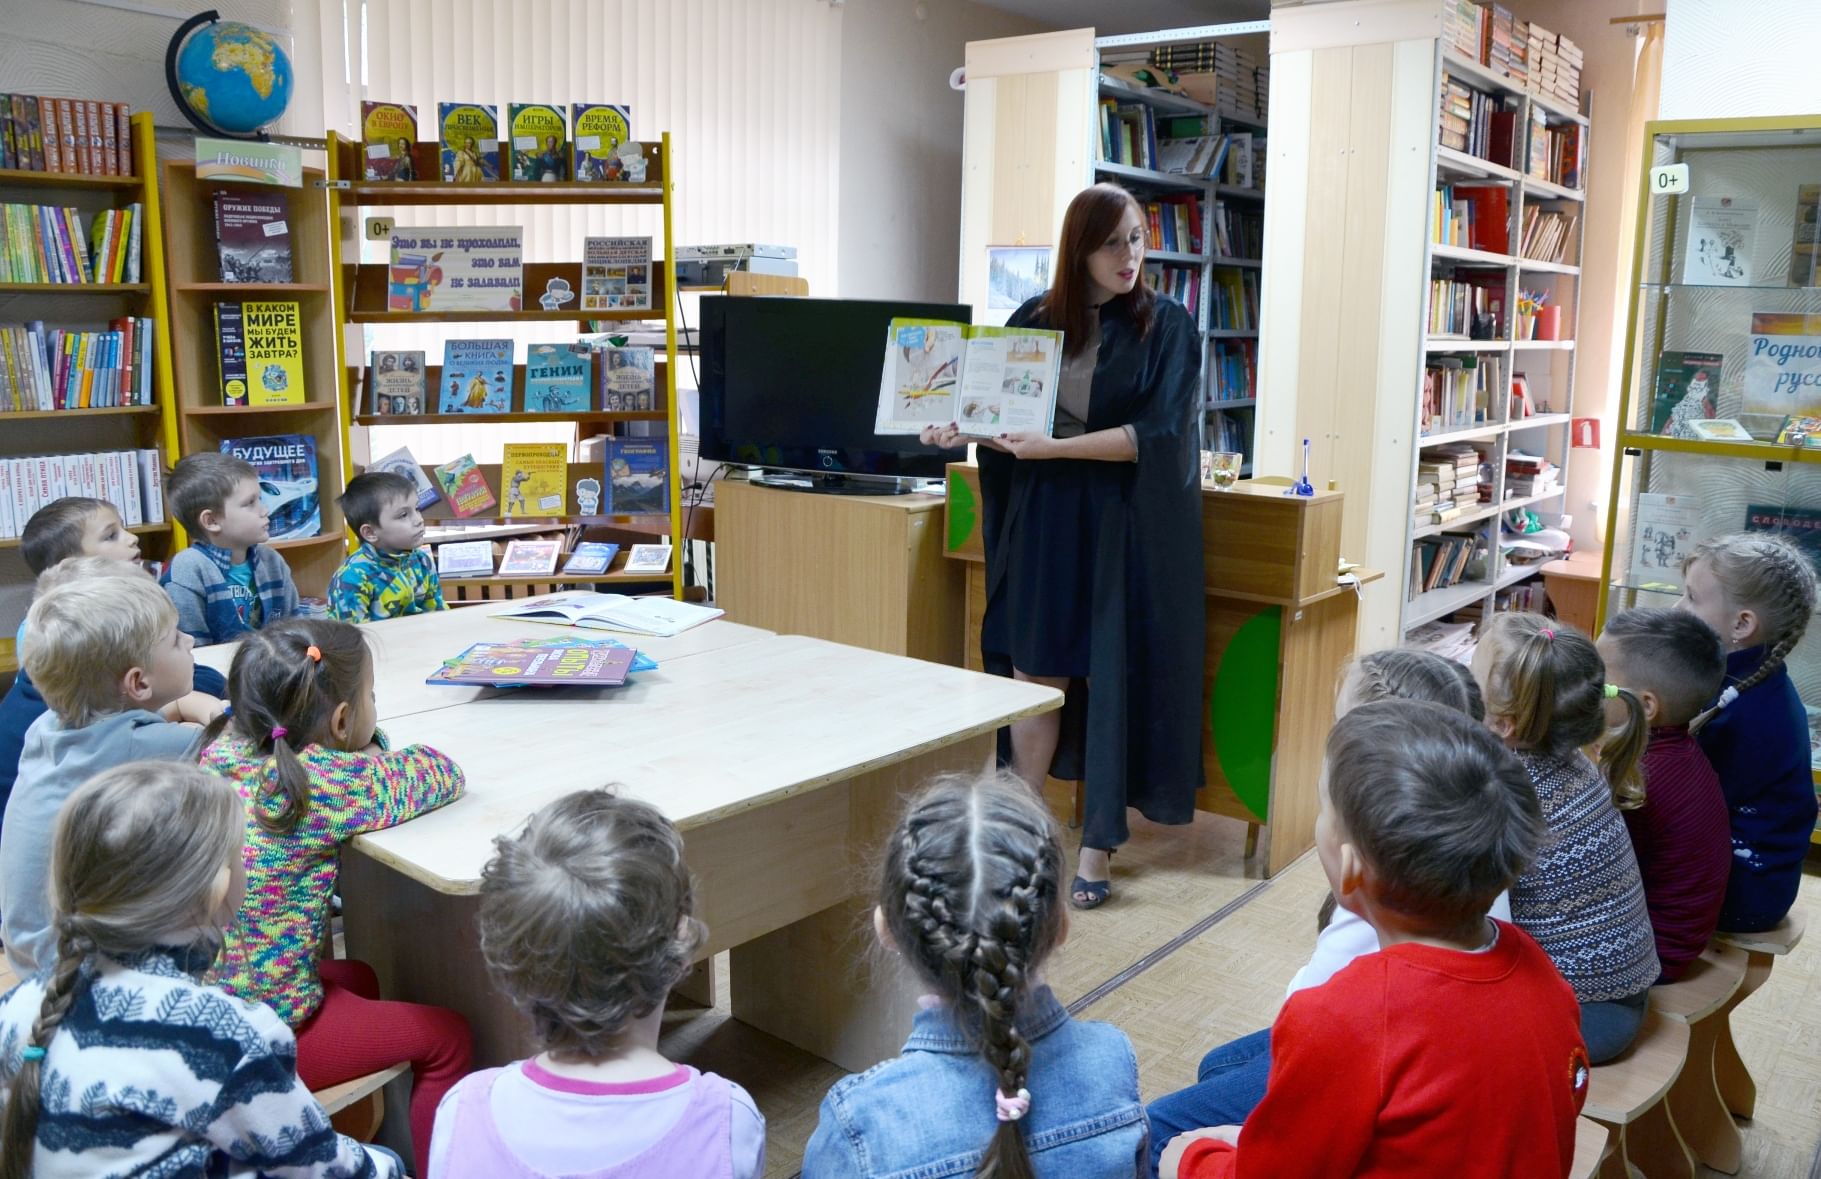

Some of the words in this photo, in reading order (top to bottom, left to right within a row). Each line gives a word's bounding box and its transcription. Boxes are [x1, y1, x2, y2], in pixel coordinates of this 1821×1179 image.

[457, 114, 481, 125] ВЕК
[523, 114, 554, 125] ИГРЫ
[585, 114, 618, 124] ВРЕМЯ
[582, 123, 621, 132] РЕФОРМ
[216, 152, 286, 170] Новинки
[1658, 172, 1679, 188] 0+
[223, 204, 251, 212] ОРУЖИЕ
[373, 222, 390, 236] 0+
[391, 235, 417, 249] Это
[246, 304, 253, 312] В
[256, 304, 295, 312] КАКОМ
[247, 313, 296, 327] МИРЕ
[265, 328, 297, 336] БУДЕМ
[249, 336, 298, 348] ЖИТЬ
[451, 341, 508, 350] БОЛЬШАЯ
[249, 349, 298, 359] ЗАВТРА?
[465, 351, 496, 359] КНИГА
[530, 365, 584, 378] ГЕНИИ
[232, 444, 305, 460] БУДУЩЕЕ
